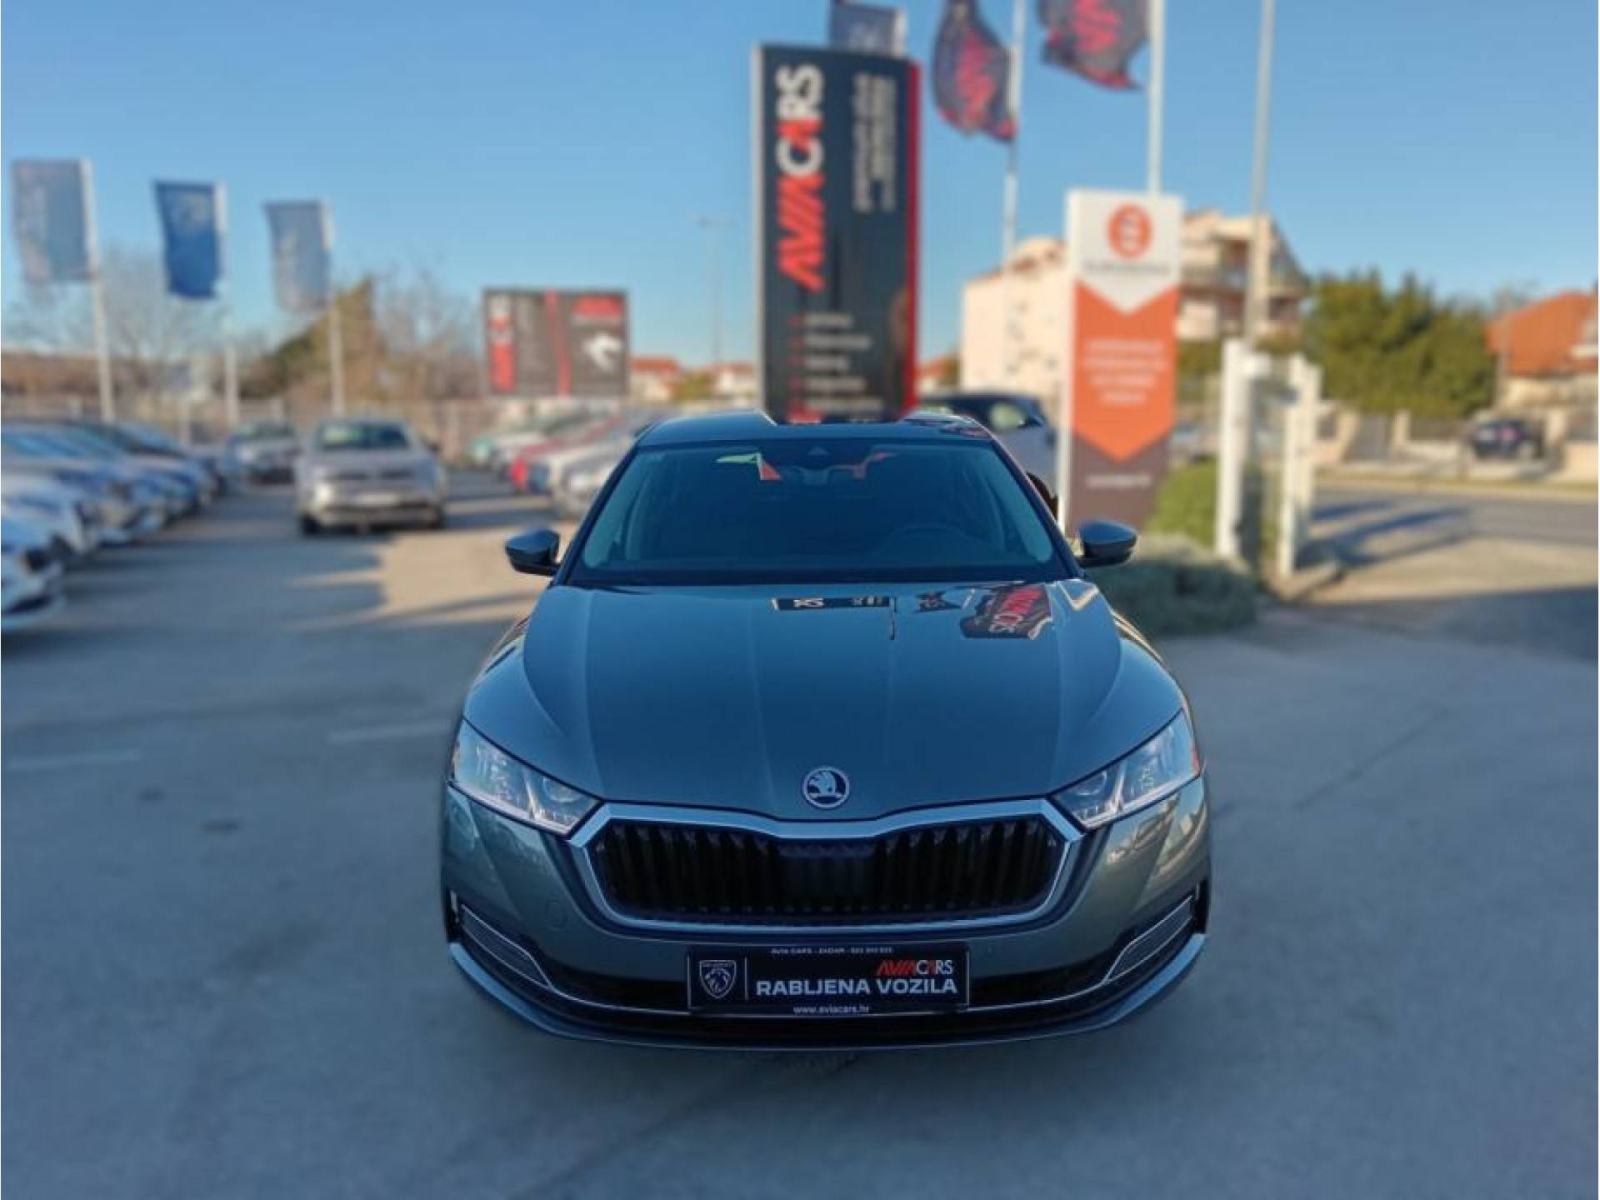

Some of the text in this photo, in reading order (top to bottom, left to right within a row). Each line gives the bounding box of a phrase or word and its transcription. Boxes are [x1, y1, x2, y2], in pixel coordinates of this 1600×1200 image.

[776, 64, 825, 293] AVIACARS
[877, 959, 954, 977] AVIACARS
[756, 978, 958, 996] RABLJENA VOZILA
